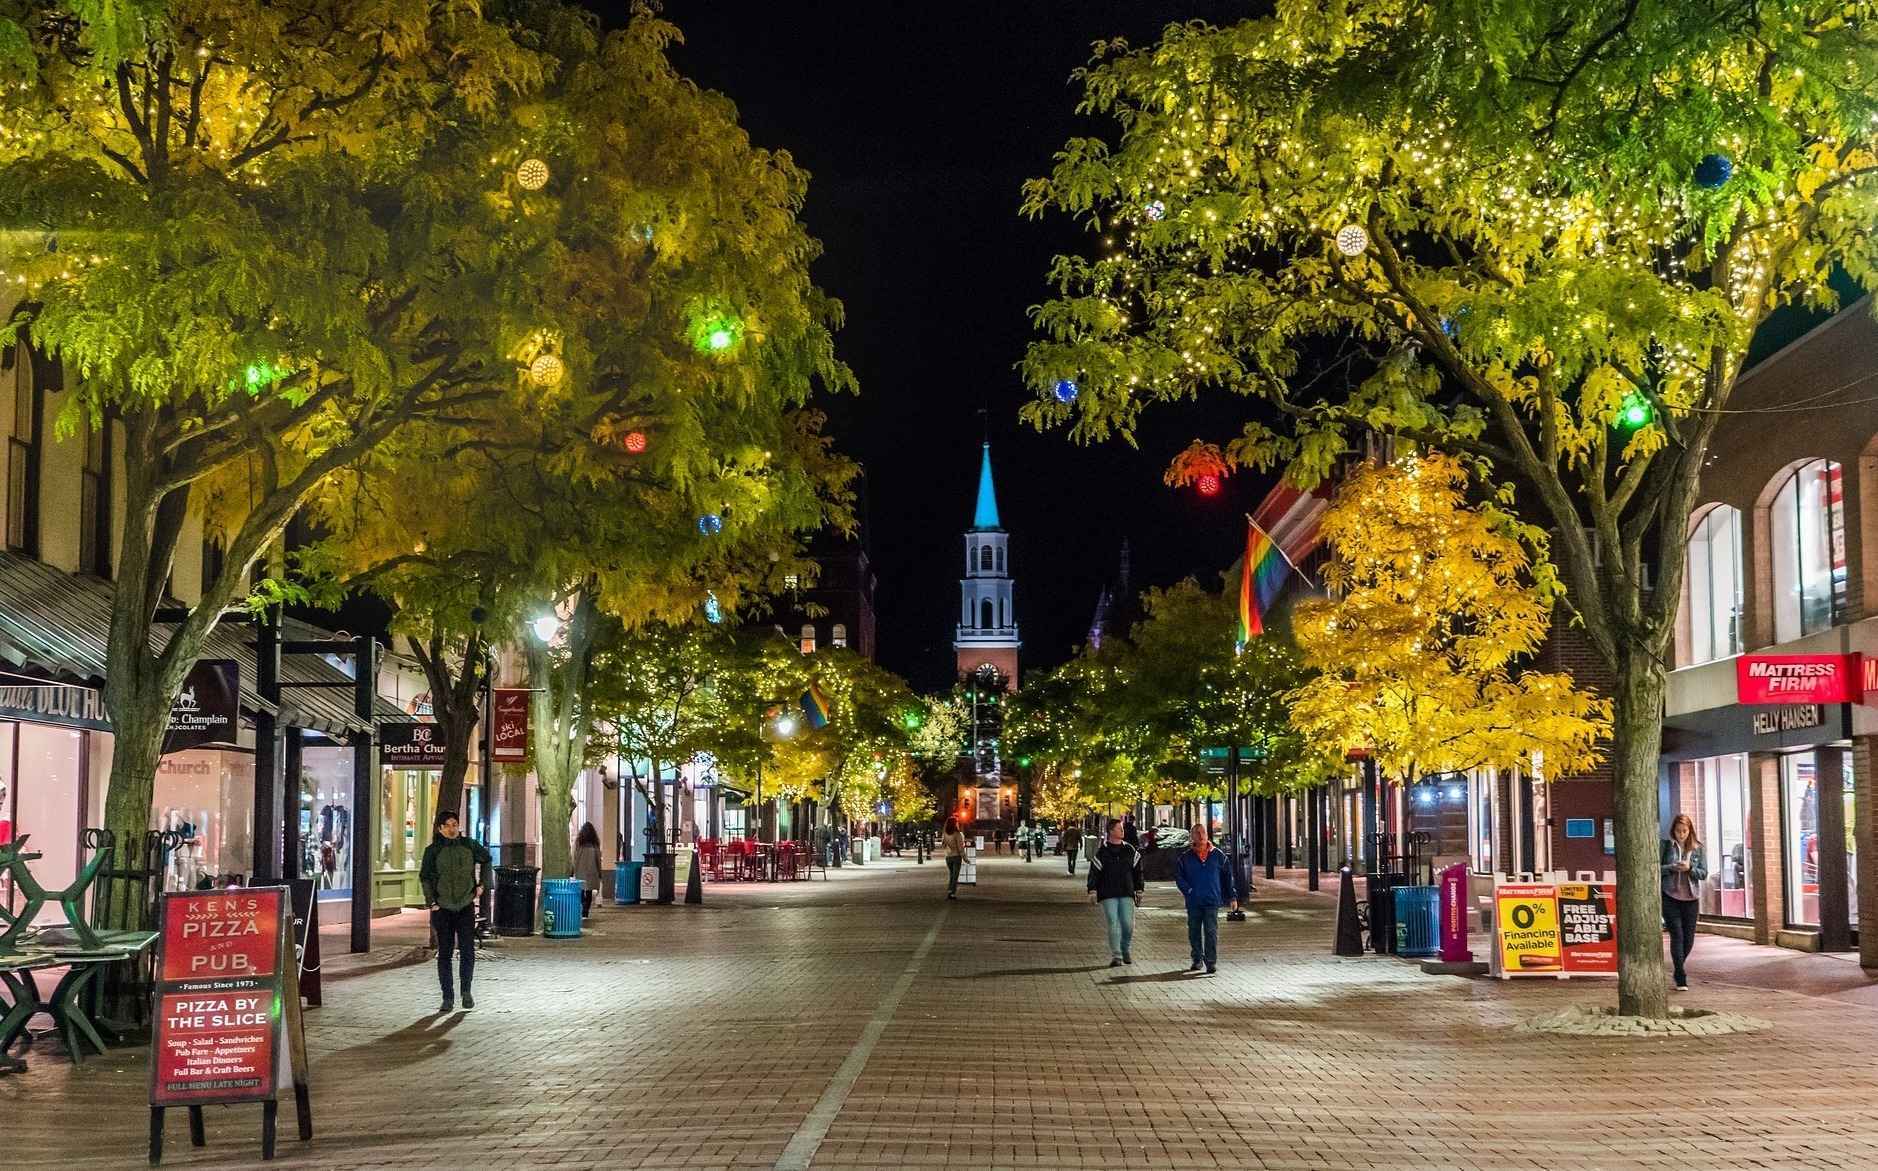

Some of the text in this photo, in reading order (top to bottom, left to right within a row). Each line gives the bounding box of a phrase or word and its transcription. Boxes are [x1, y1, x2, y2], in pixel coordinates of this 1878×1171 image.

[1749, 663, 1836, 677] MATTRESS
[1768, 677, 1817, 691] FIRM
[182, 713, 228, 726] Champlain
[1753, 704, 1818, 735] HELLY HANSEN
[496, 728, 526, 742] LOCAL
[384, 743, 420, 753] Bertha
[189, 899, 257, 912] KEN'S
[1563, 904, 1596, 914] FREE
[1564, 914, 1616, 924] ADJUST
[183, 920, 259, 938] PIZZA
[1504, 929, 1556, 941] Financing
[1565, 933, 1600, 943] BASE
[1506, 939, 1554, 951] Available
[191, 953, 248, 971] PUB
[176, 999, 259, 1013] PIZZA BY
[167, 1013, 267, 1028] THE SLICE
[167, 1039, 187, 1048] Soup
[193, 1037, 214, 1046] Salad
[219, 1036, 265, 1044] Sandwiches
[175, 1048, 191, 1056] Pub
[192, 1047, 209, 1055] Fare
[187, 1056, 243, 1066] Italian Dinners
[174, 1065, 255, 1076] Full Bar & Craft Beers
[189, 1081, 212, 1089] MENU
[213, 1080, 233, 1088] LATE
[234, 1079, 260, 1087] NIGHT
